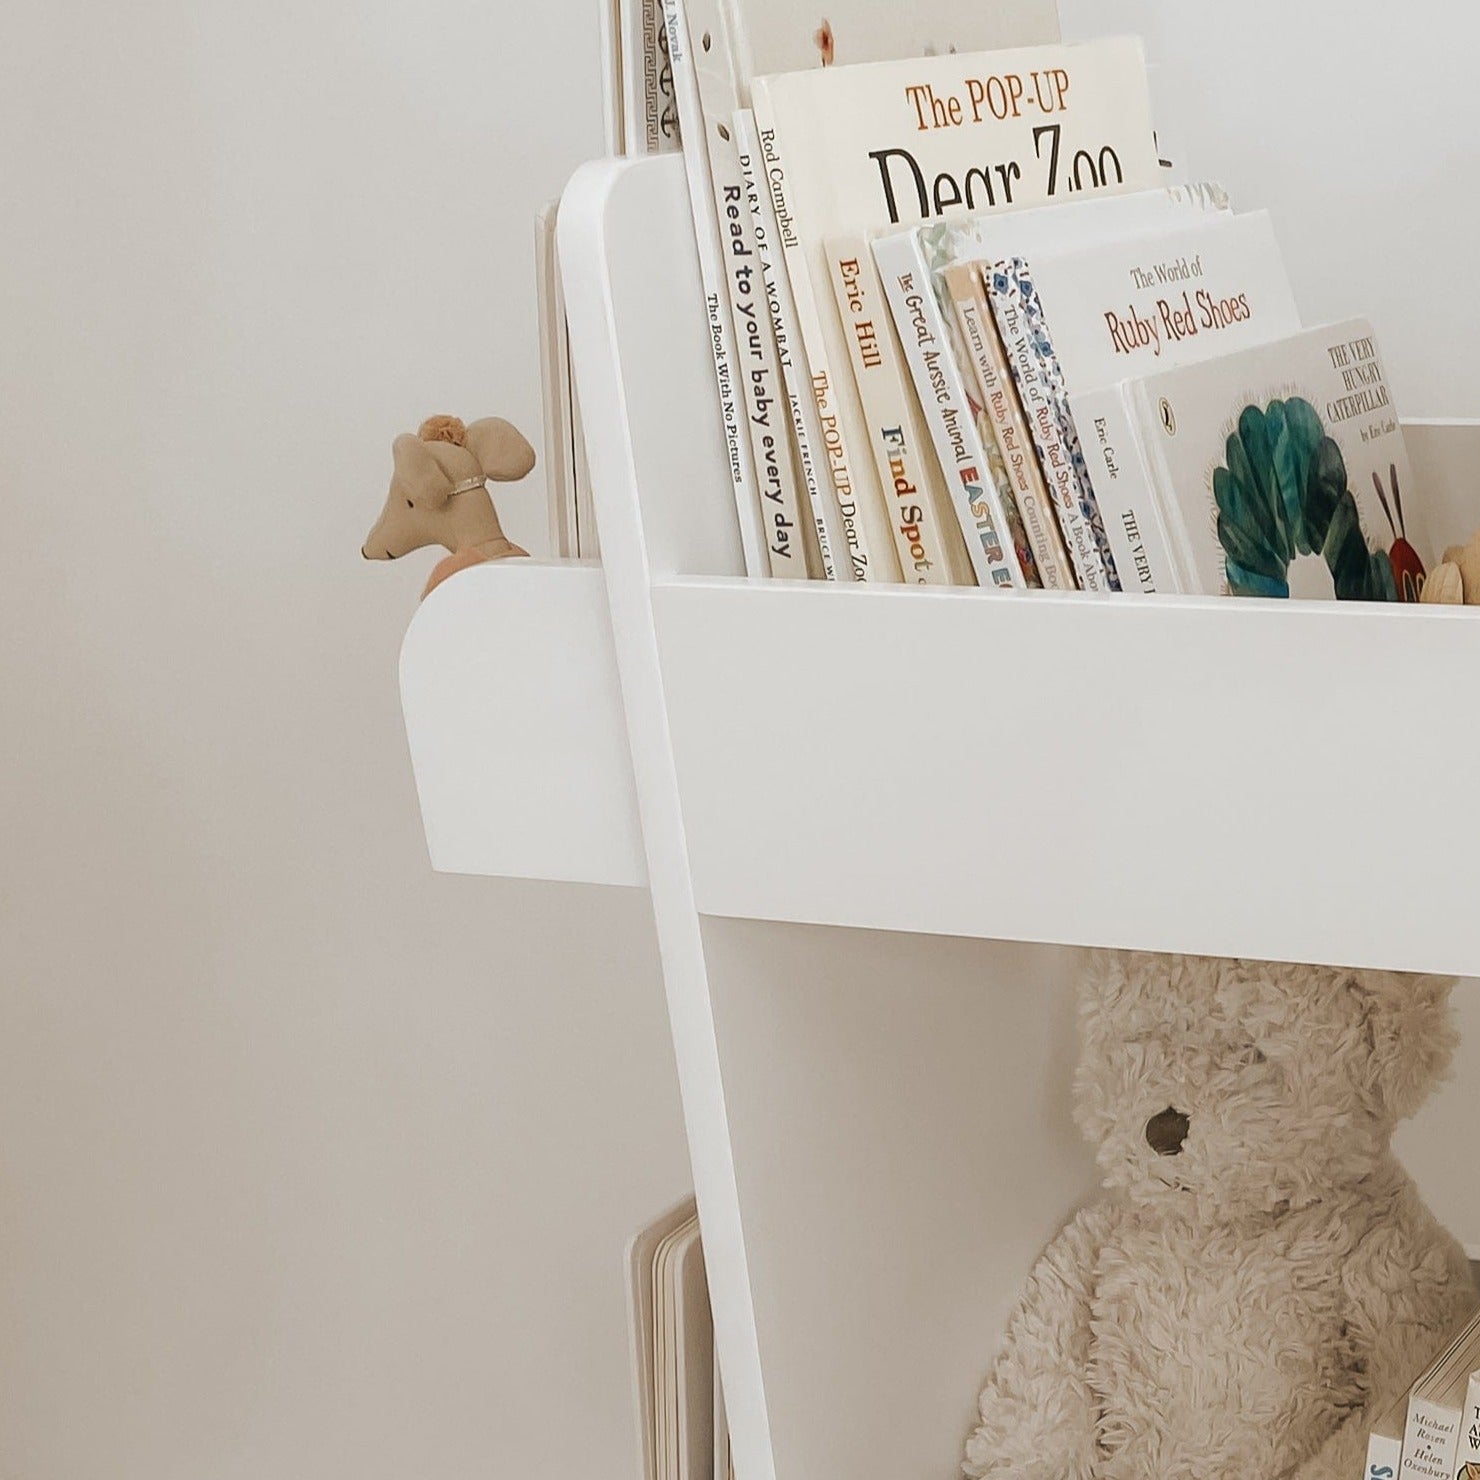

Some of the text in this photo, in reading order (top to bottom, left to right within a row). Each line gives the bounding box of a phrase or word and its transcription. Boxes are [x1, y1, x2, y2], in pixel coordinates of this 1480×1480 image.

[666, 13, 683, 63] Novak
[906, 69, 1071, 130] The POP-UP
[868, 147, 1021, 224] Dear
[1032, 124, 1123, 196] Zoo
[1130, 255, 1203, 289] The World of
[739, 154, 831, 559] DIARY OF A WOMBAT JACKIE FRENCH BRUCE
[761, 128, 858, 549] Rod Campbell The POP-UP Dear
[1104, 288, 1251, 357] Ruby Red Shoes
[1328, 336, 1376, 369] THE VERY
[707, 292, 742, 483] The Book With No Pictures
[723, 185, 794, 559] Read to your baby every day
[1326, 385, 1390, 424] CATERPILLAR
[1342, 361, 1382, 391] HUNGRY
[839, 257, 934, 573] Eric Hill Find Spot
[900, 272, 1004, 564] The Great Aussie Animal EASTER
[963, 307, 1051, 563] Learn with Ruby Red Shoes Counting
[1004, 304, 1088, 564] The World of Ruby Red Shoes A Book
[1094, 417, 1108, 444] Eric
[1103, 446, 1119, 480] Carle
[1122, 509, 1141, 543] THE
[1132, 545, 1154, 584] VERY
[1413, 1413, 1455, 1433] Michael
[1414, 1449, 1443, 1465] Helen
[1416, 1428, 1446, 1445] Rosen
[1404, 1458, 1451, 1480] Oxenbury
